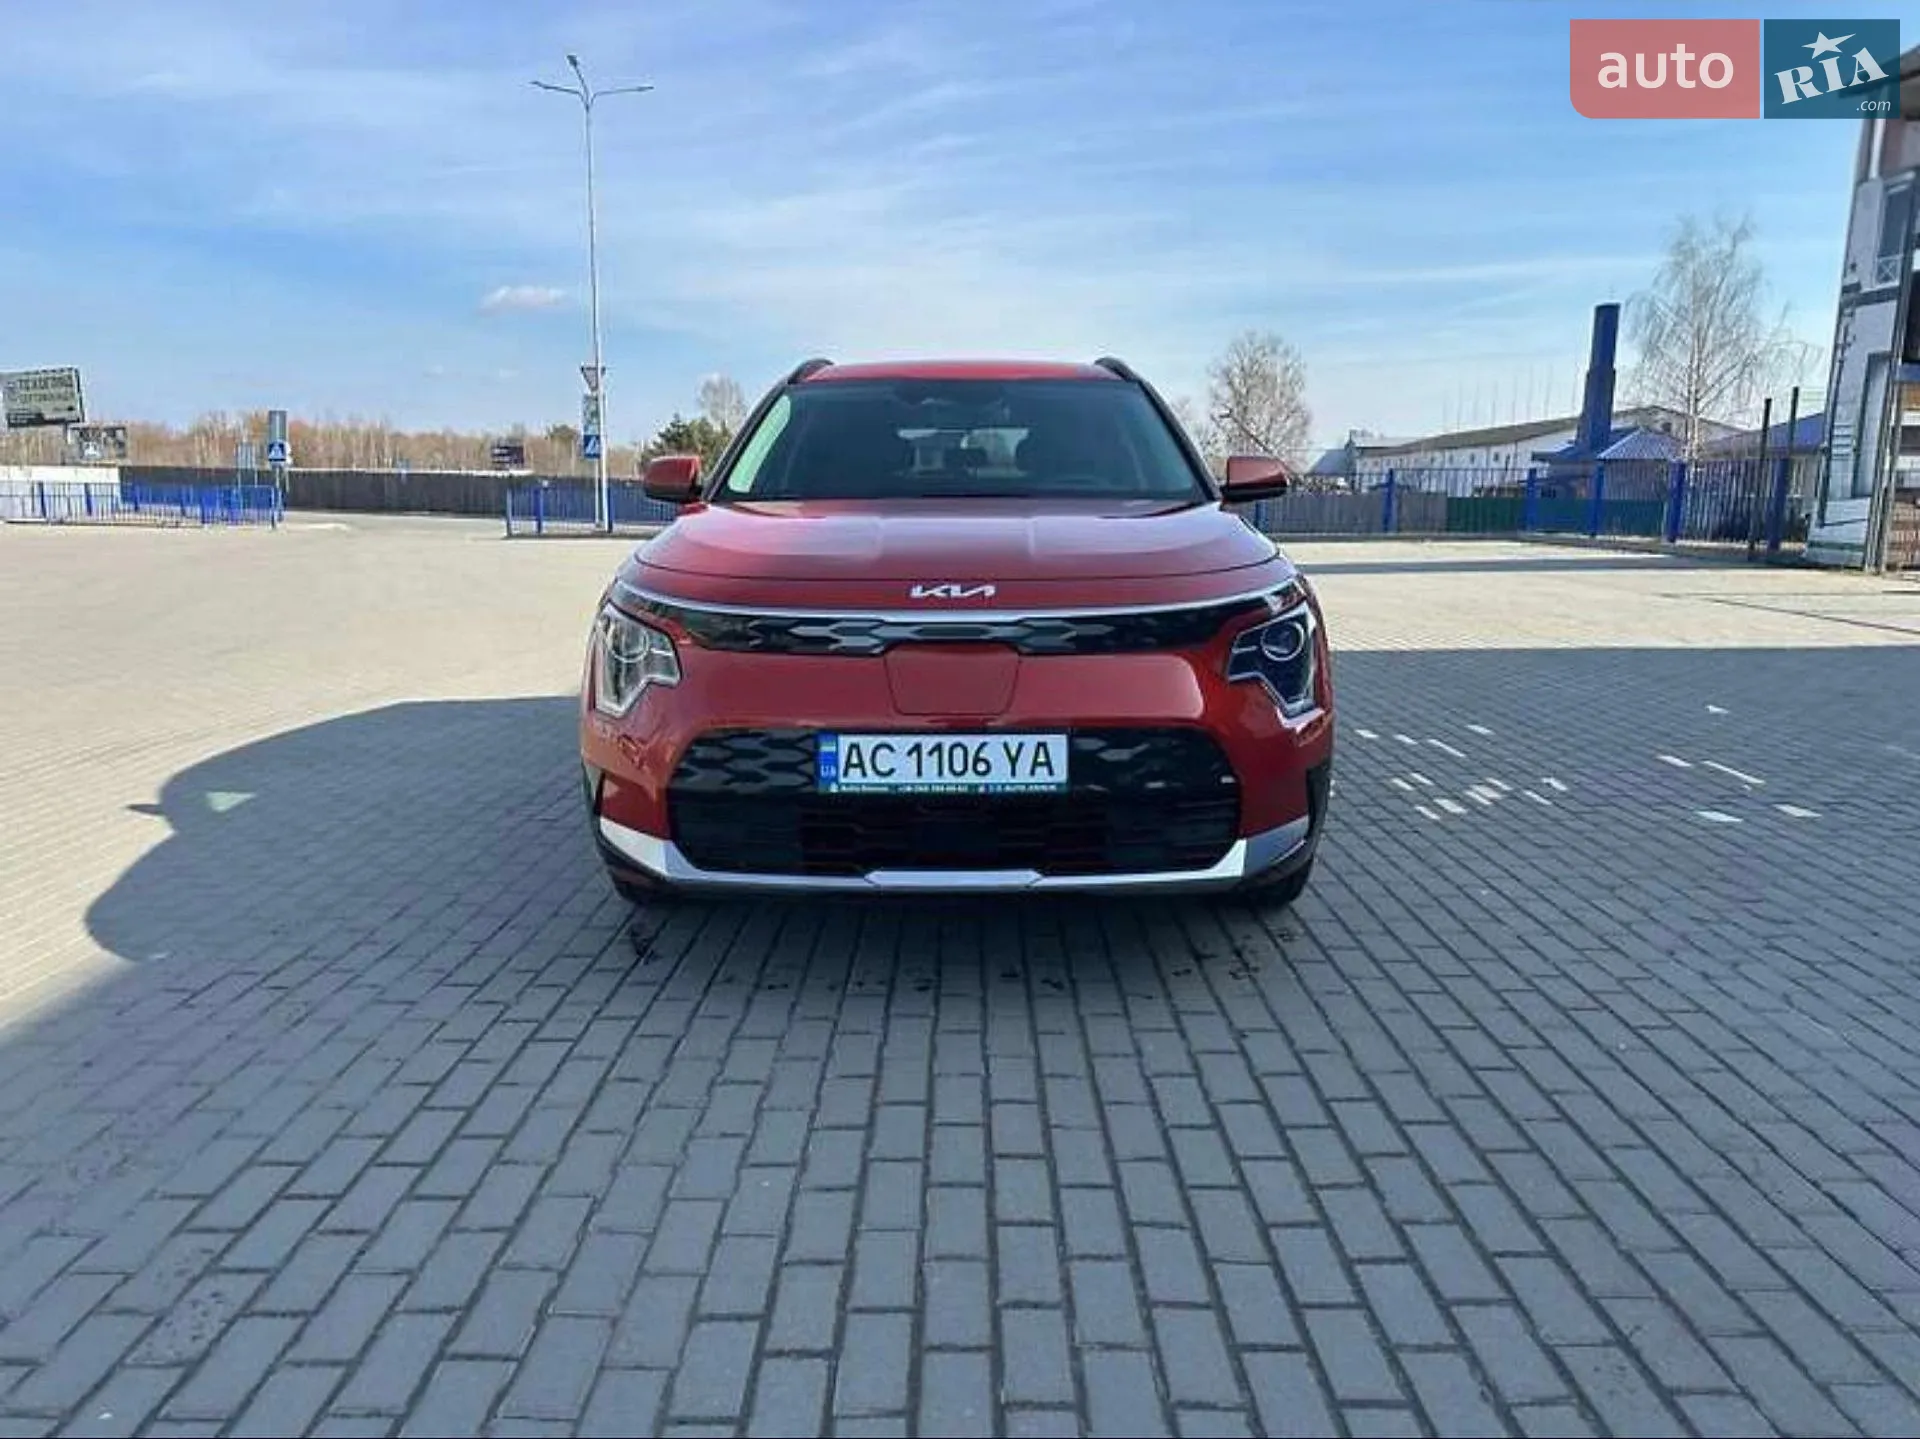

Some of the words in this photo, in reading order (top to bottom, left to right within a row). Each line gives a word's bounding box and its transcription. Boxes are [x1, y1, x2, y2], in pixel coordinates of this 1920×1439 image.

[842, 741, 897, 778] AC
[906, 741, 993, 778] 1106
[1002, 740, 1055, 778] YA
